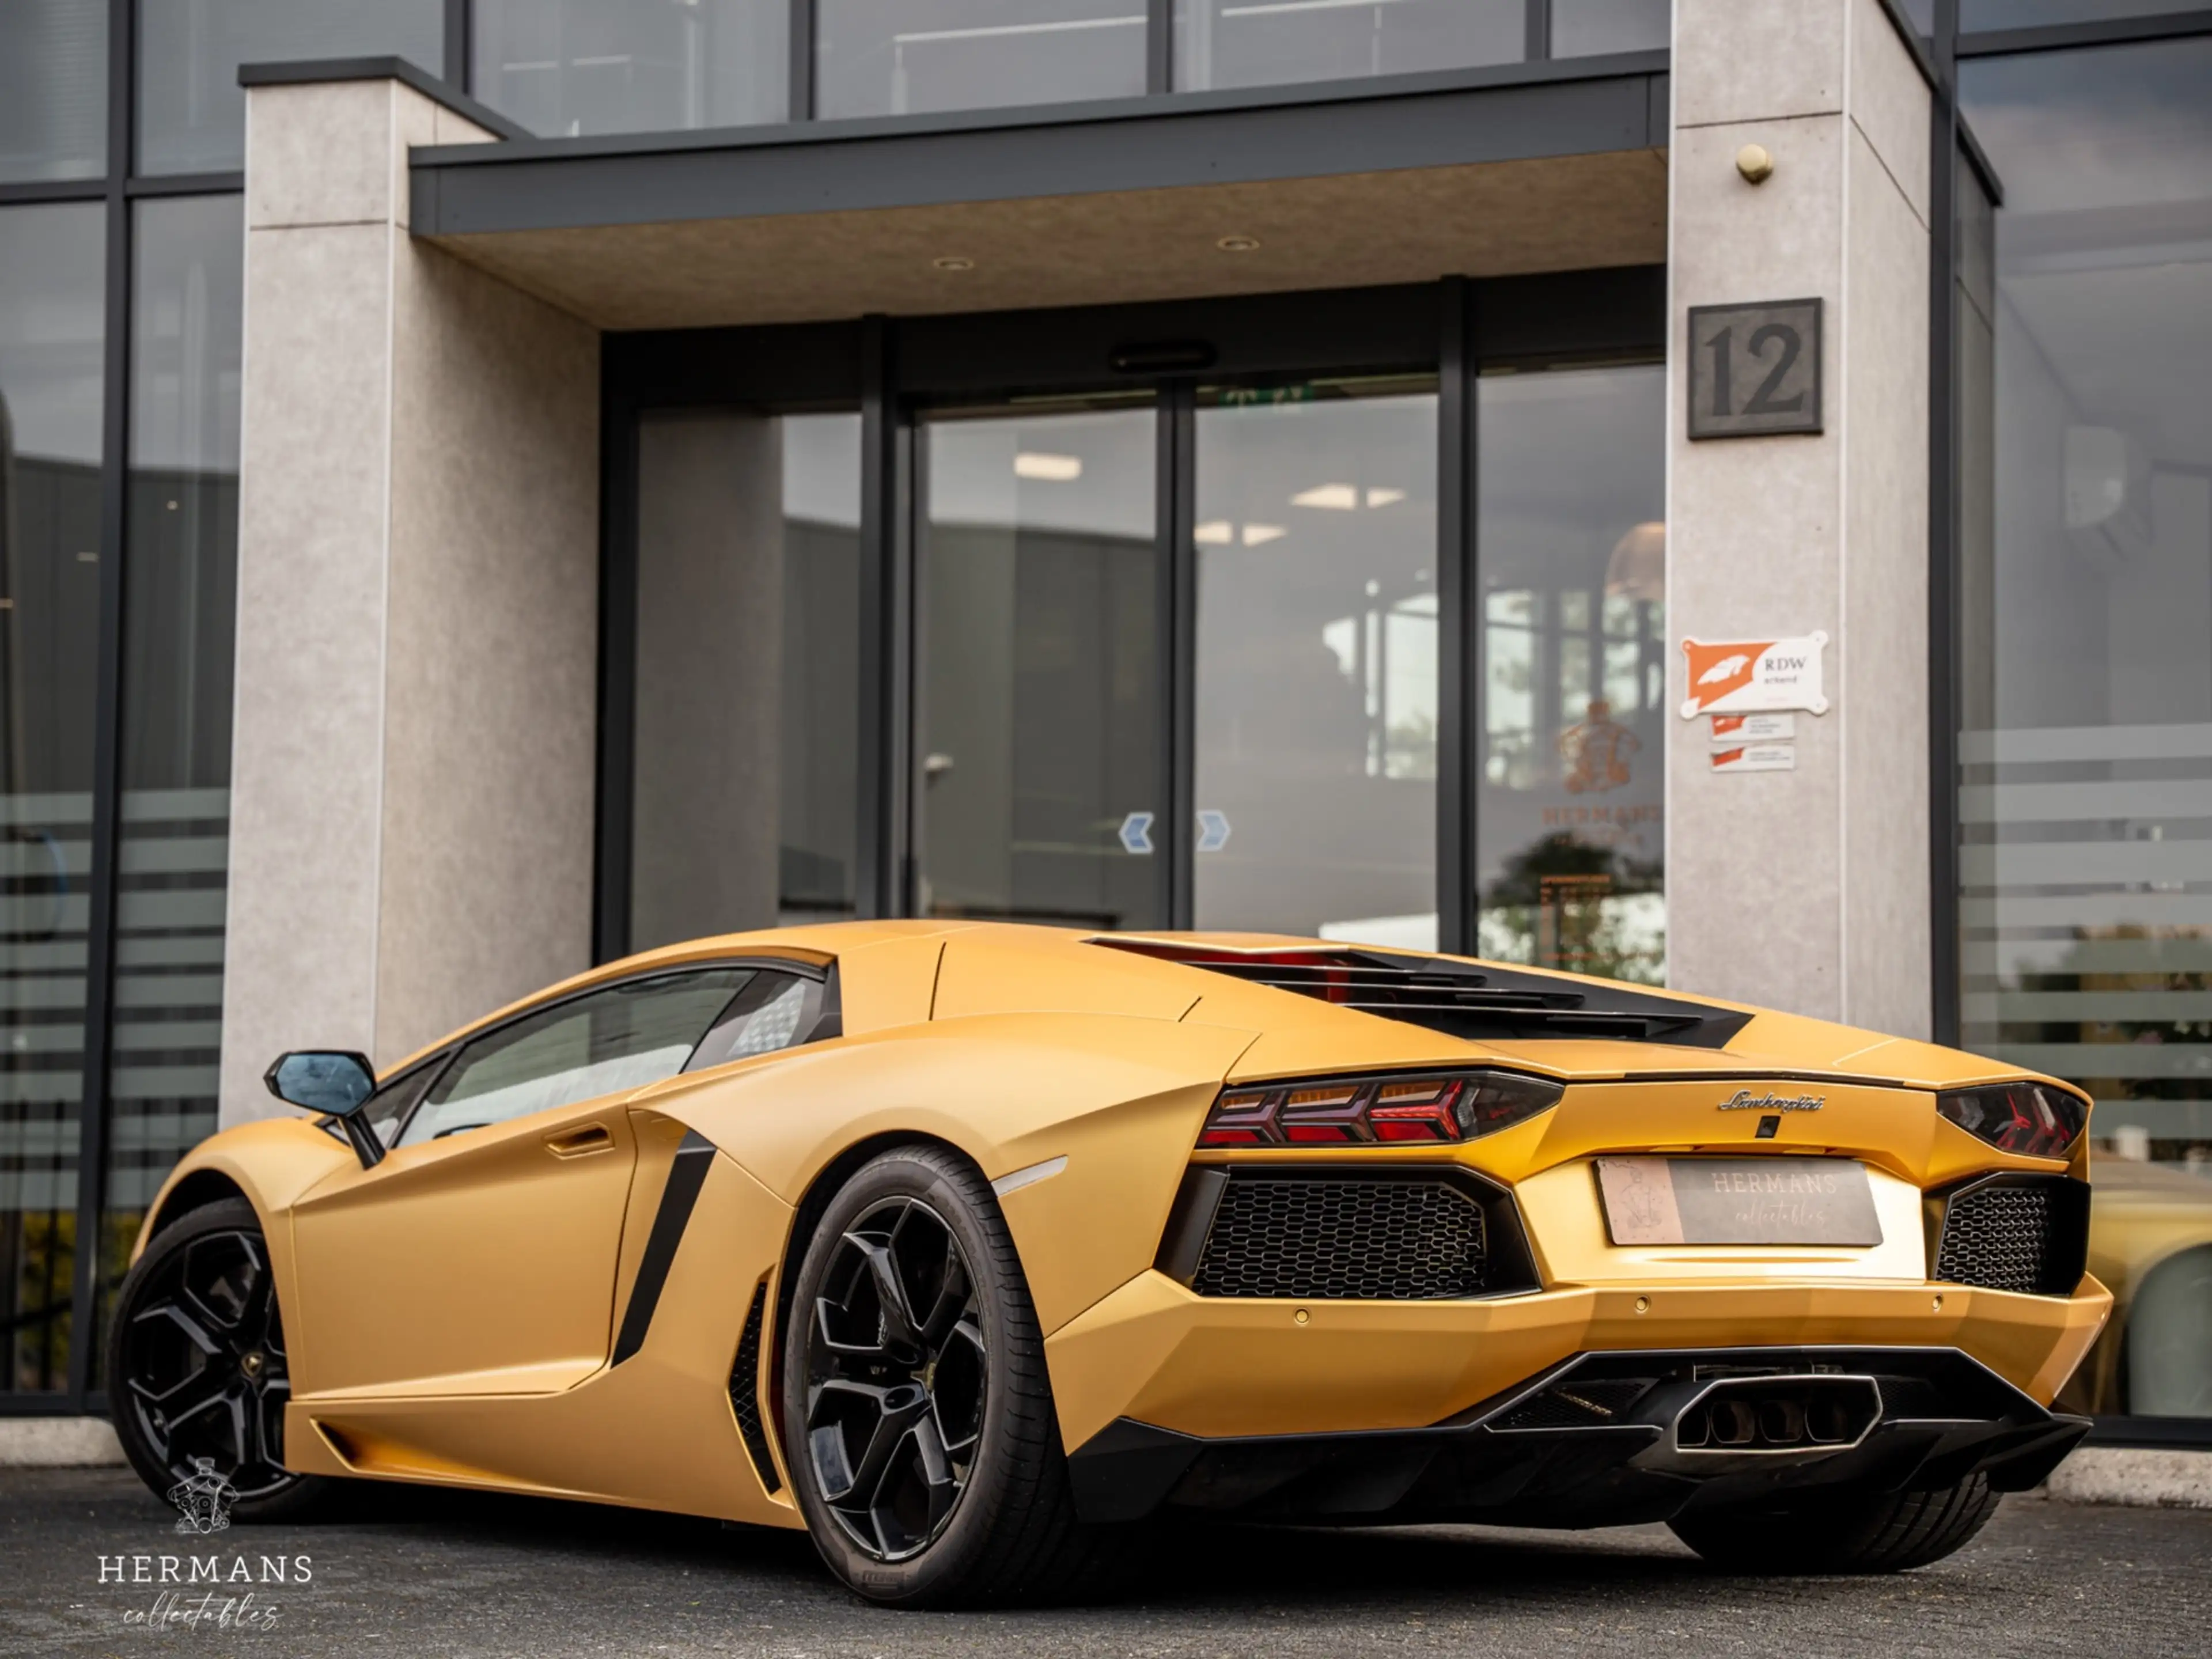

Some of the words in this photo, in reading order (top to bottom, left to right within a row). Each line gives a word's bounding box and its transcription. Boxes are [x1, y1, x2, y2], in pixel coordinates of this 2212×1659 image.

[1705, 323, 1804, 416] 12
[1764, 656, 1808, 672] RDW
[1718, 1089, 1825, 1113] Lamborghini
[1713, 1172, 1837, 1194] HERMANS
[1735, 1199, 1827, 1229] collectables
